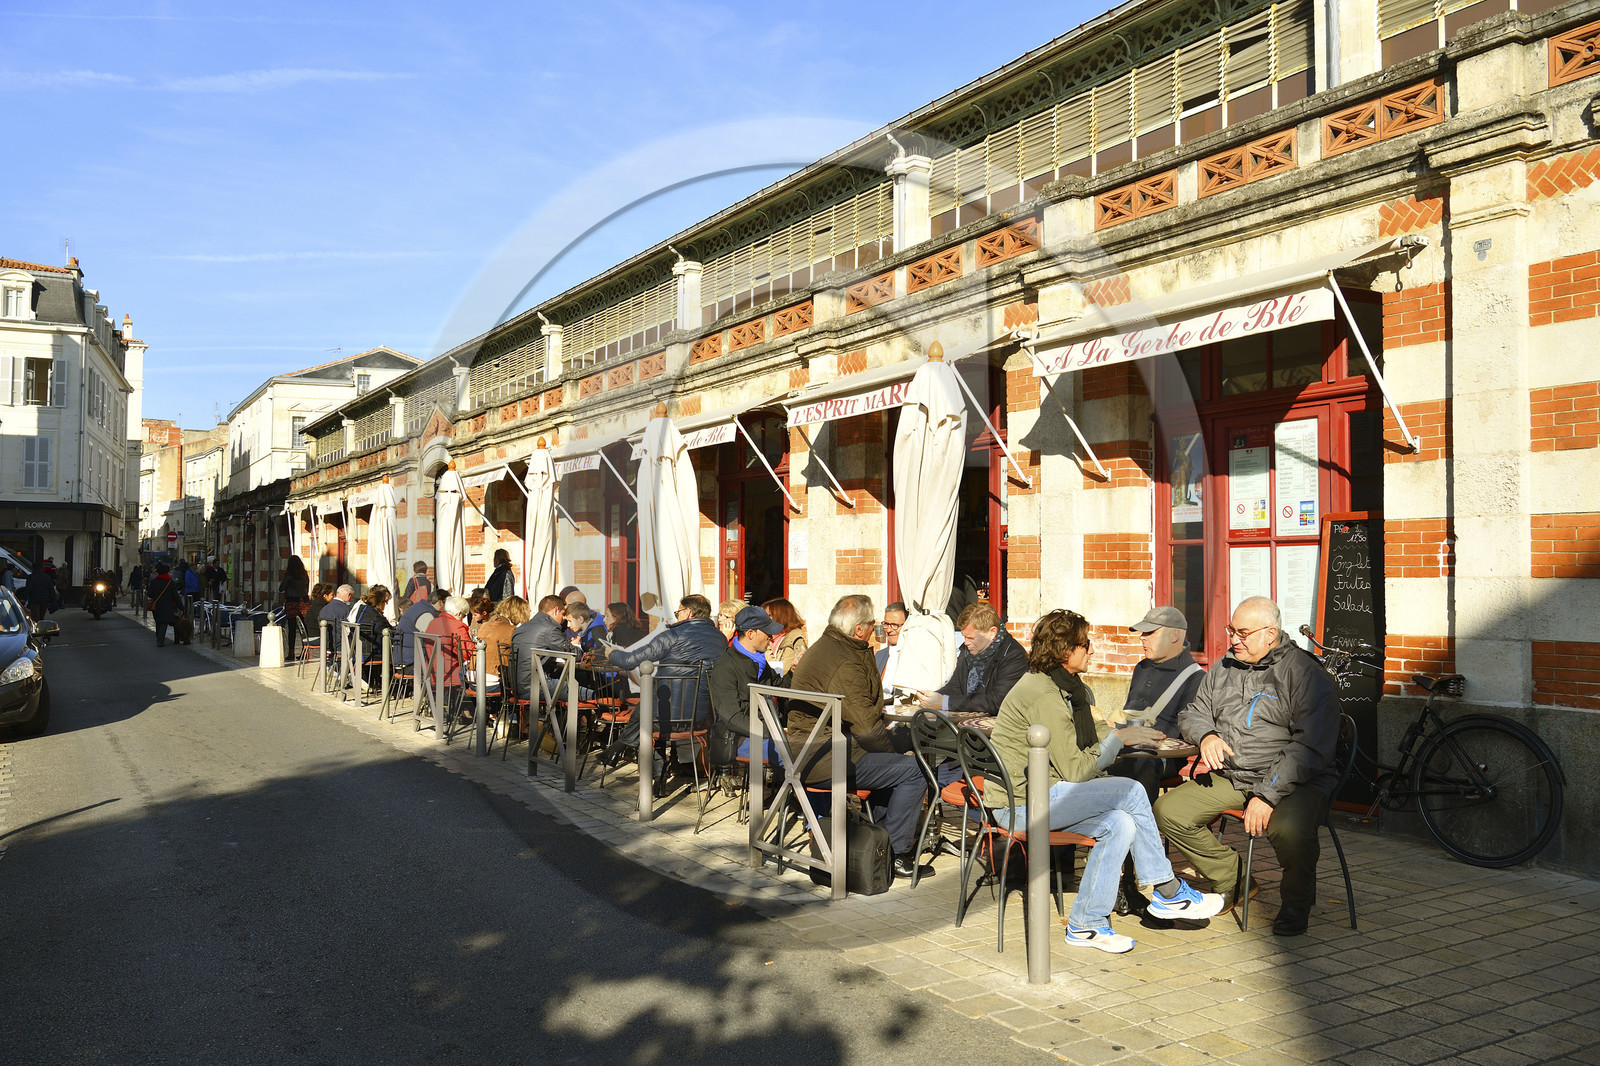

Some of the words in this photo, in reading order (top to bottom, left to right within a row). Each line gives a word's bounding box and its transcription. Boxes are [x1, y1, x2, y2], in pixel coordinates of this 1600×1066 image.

[1046, 343, 1074, 373] A
[1077, 337, 1115, 367] La
[1122, 322, 1197, 358] Gerbe
[1199, 311, 1239, 341] de
[1243, 294, 1309, 331] Blé
[793, 399, 859, 425] L'ESPRIT
[705, 426, 728, 444] Blé
[1333, 574, 1371, 590] Frites
[1333, 594, 1373, 614] Salade
